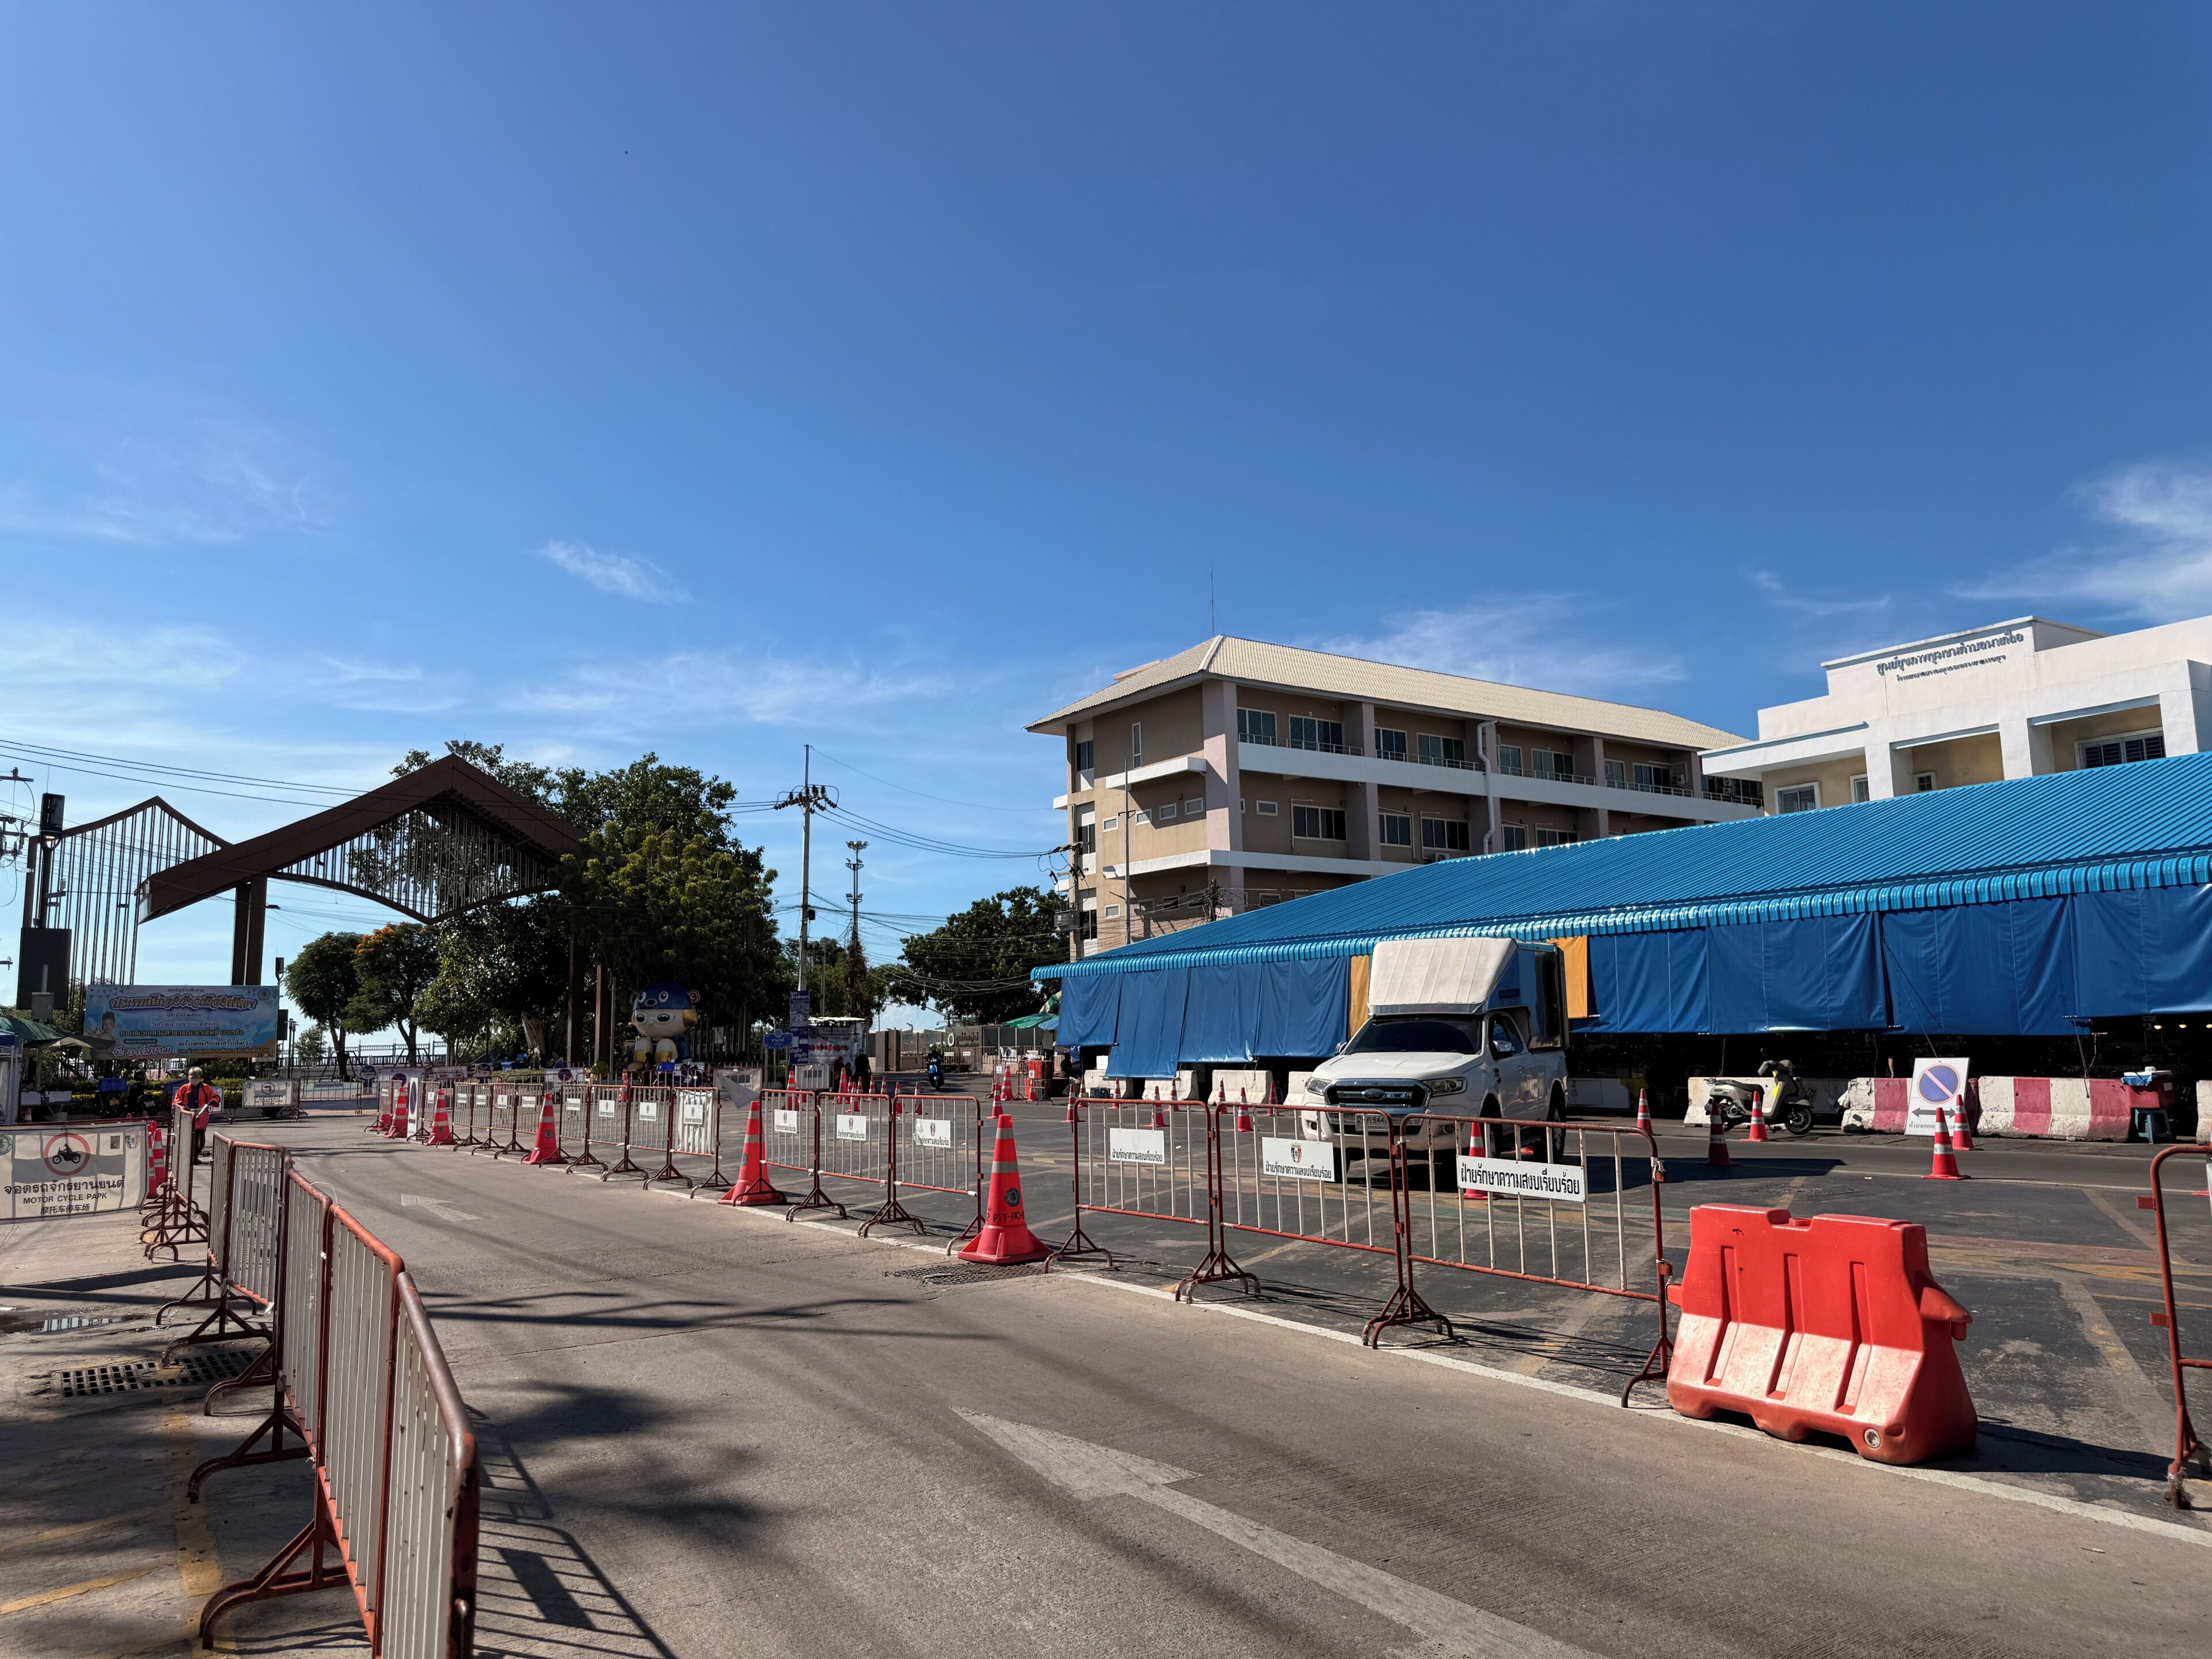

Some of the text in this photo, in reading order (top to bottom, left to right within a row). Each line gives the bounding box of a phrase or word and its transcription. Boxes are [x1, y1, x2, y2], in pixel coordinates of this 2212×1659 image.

[1112, 1148, 1162, 1162] ฝ่ายรักษาความสงบเรียบร้อย
[1265, 1160, 1332, 1179] ฝ่ายรักษาความสงบเรียบร้อย
[4, 1175, 126, 1195] จอดรถจักรยานยนต์
[1461, 1162, 1580, 1195] ฝ่ายรักษาความสงบเรียบร้อย
[23, 1195, 54, 1205] MOTOR
[57, 1194, 84, 1202] CYCLE
[41, 1203, 90, 1215] 摩托车停车场
